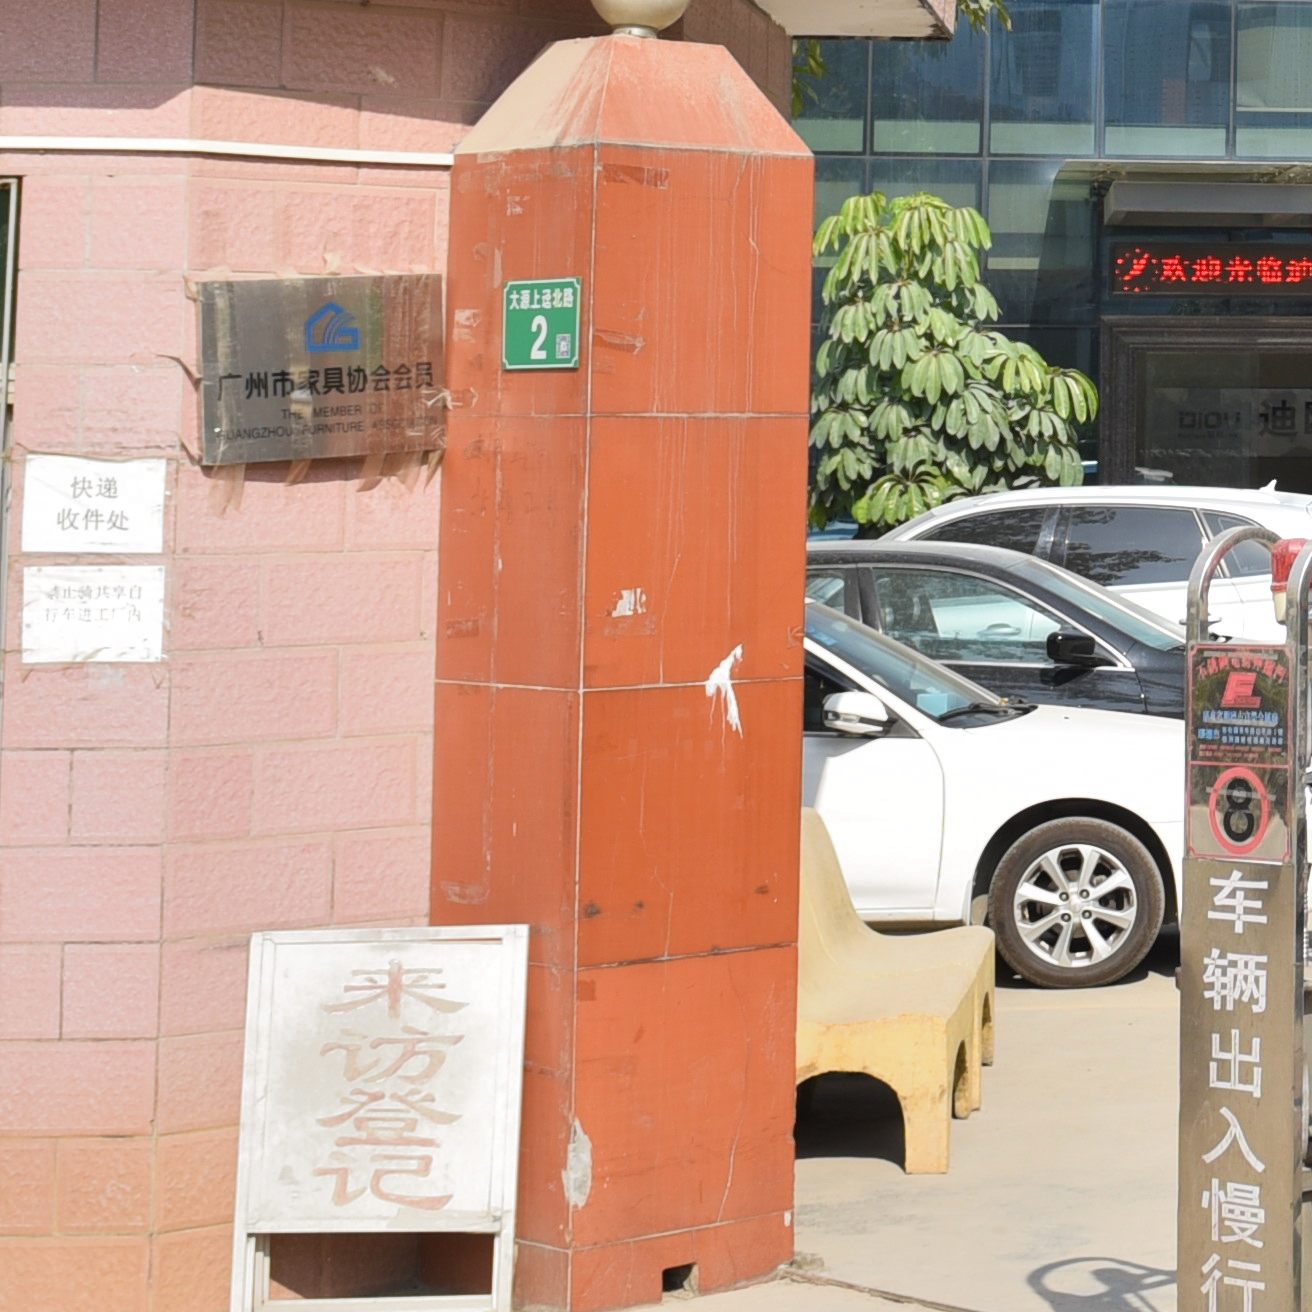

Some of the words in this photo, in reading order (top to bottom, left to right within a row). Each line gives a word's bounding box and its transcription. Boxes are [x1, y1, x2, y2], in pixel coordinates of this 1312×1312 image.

[530, 314, 548, 360] 2
[217, 362, 434, 401] 广州市家具协会会员
[313, 405, 361, 419] MEMBER
[69, 476, 119, 500] 快递
[56, 507, 130, 532] 收件处
[313, 958, 470, 1211] 来访登记
